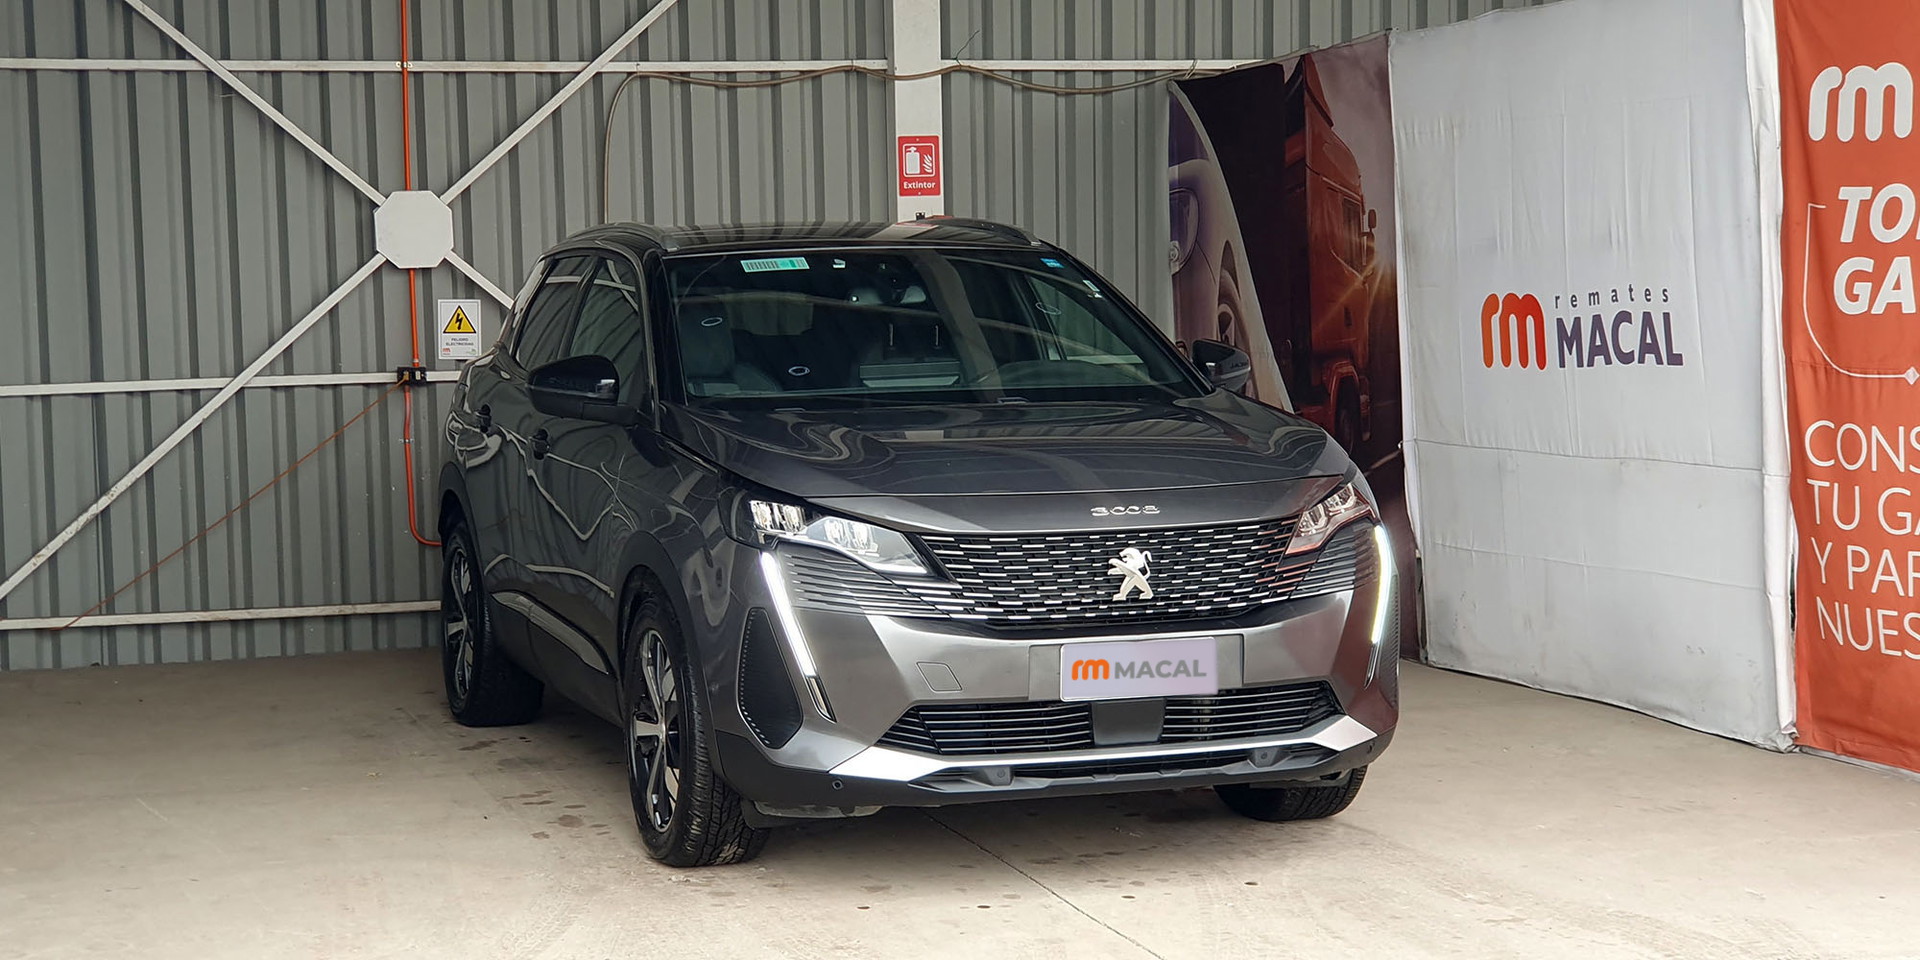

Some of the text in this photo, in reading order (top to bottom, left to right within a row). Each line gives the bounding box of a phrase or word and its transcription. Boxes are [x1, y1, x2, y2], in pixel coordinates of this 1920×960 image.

[903, 181, 936, 189] Extintor
[1838, 183, 1920, 243] TO
[1555, 284, 1669, 309] remates
[1556, 310, 1684, 368] MACAL
[1807, 479, 1920, 535] TU G
[1811, 537, 1833, 584] Y
